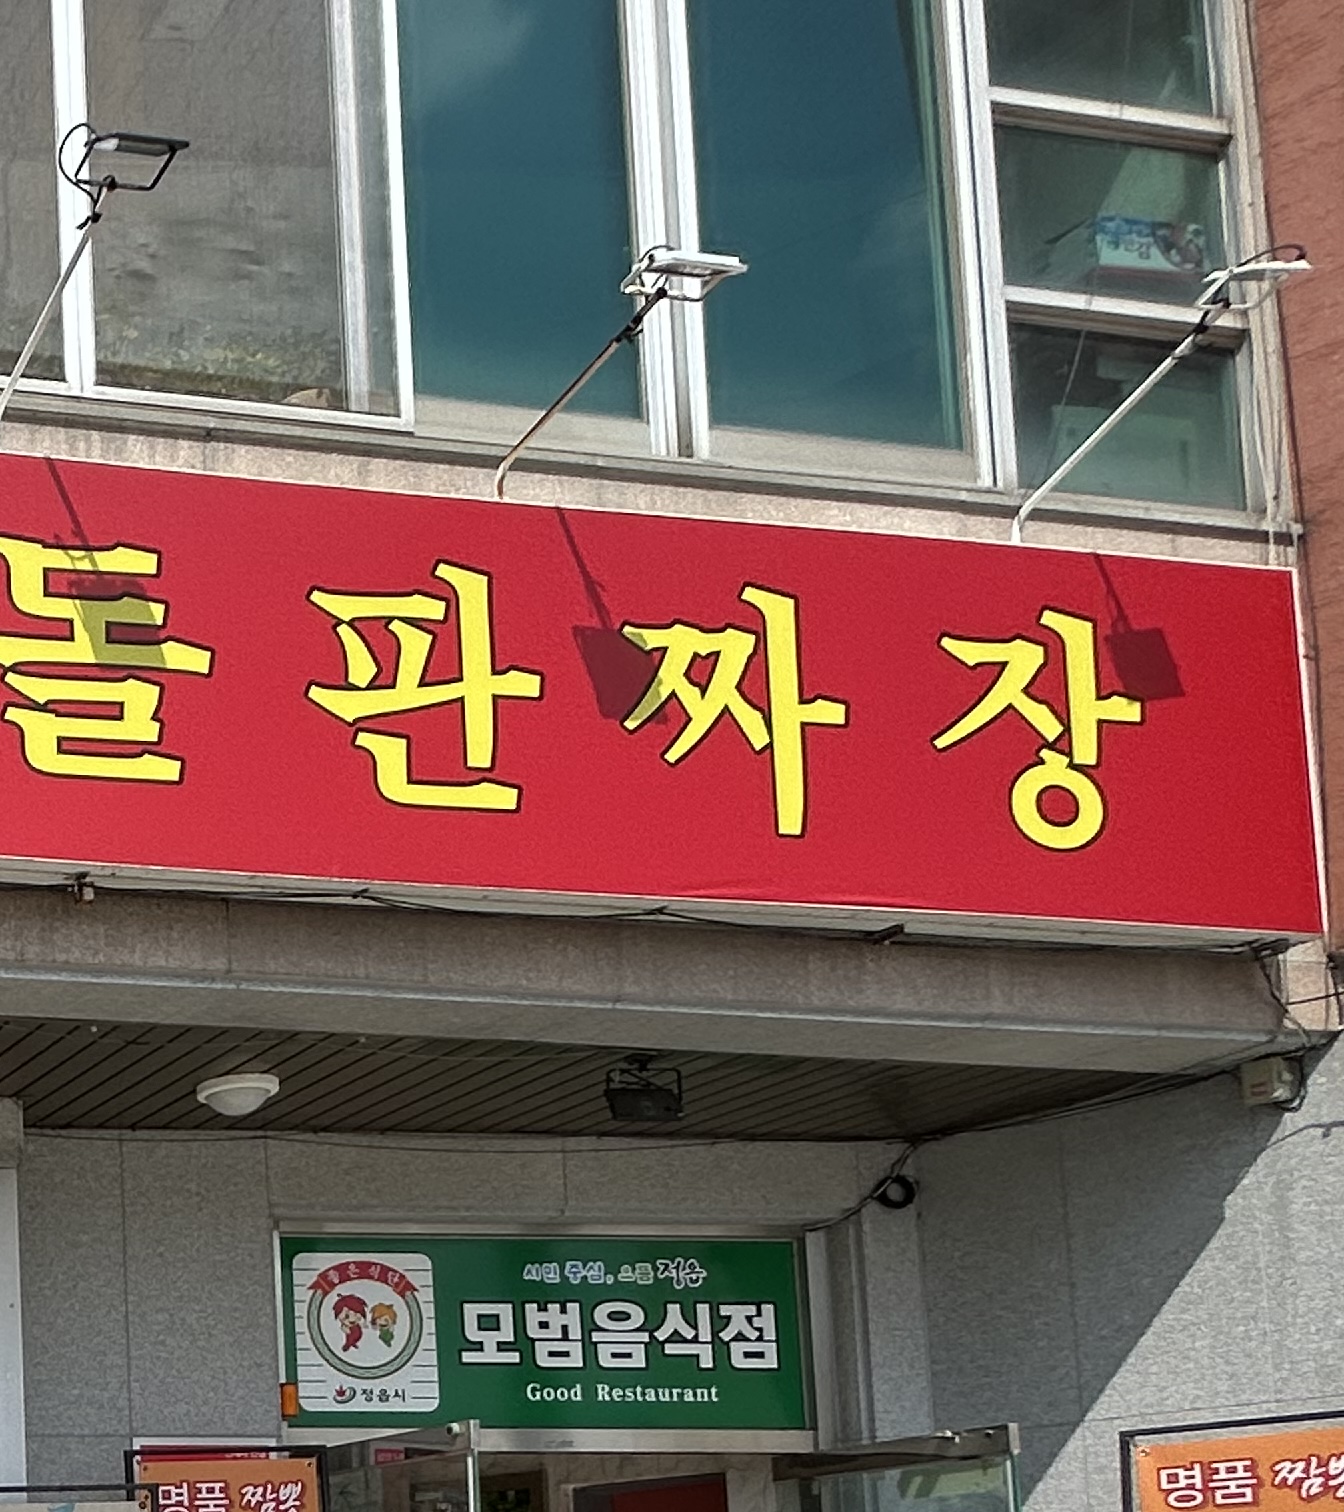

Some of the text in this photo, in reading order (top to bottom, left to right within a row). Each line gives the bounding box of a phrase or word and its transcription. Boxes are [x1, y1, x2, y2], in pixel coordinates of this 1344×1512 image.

[460, 1300, 781, 1370] 모범음식점
[360, 1388, 406, 1403] 정읍시
[526, 1382, 720, 1402] Good Restaurant
[1158, 1457, 1258, 1508] 명품
